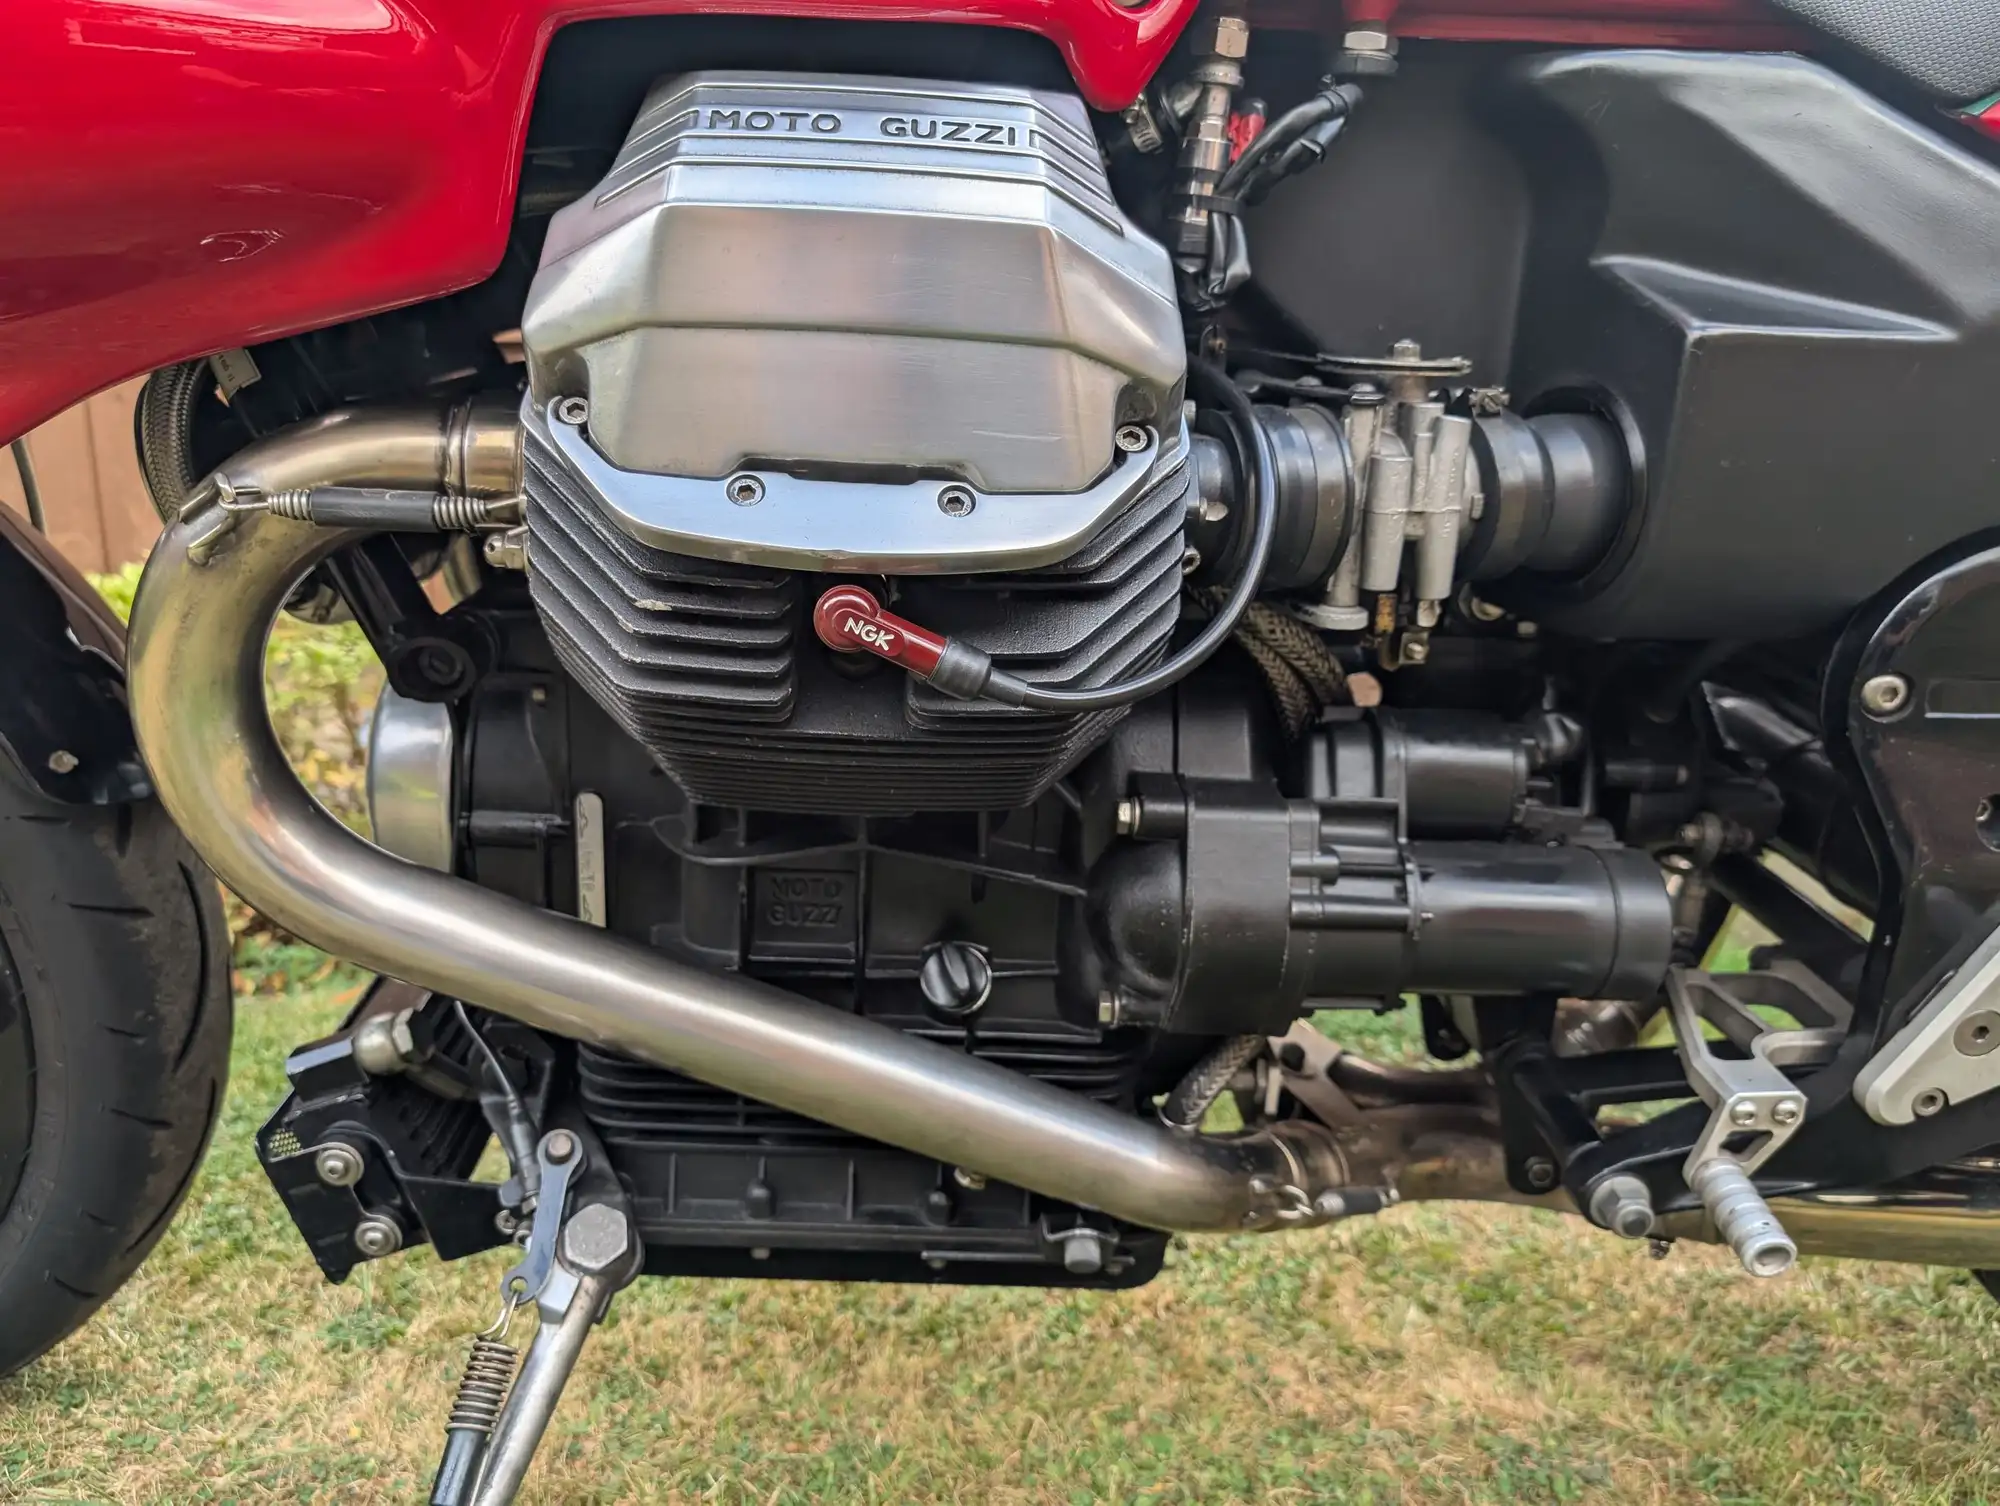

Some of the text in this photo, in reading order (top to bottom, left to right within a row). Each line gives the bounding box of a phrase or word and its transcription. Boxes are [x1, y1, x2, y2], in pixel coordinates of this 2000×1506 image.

[708, 109, 1016, 147] MOTO GUZZI
[843, 616, 895, 651] NGK
[770, 876, 844, 900] MOTO
